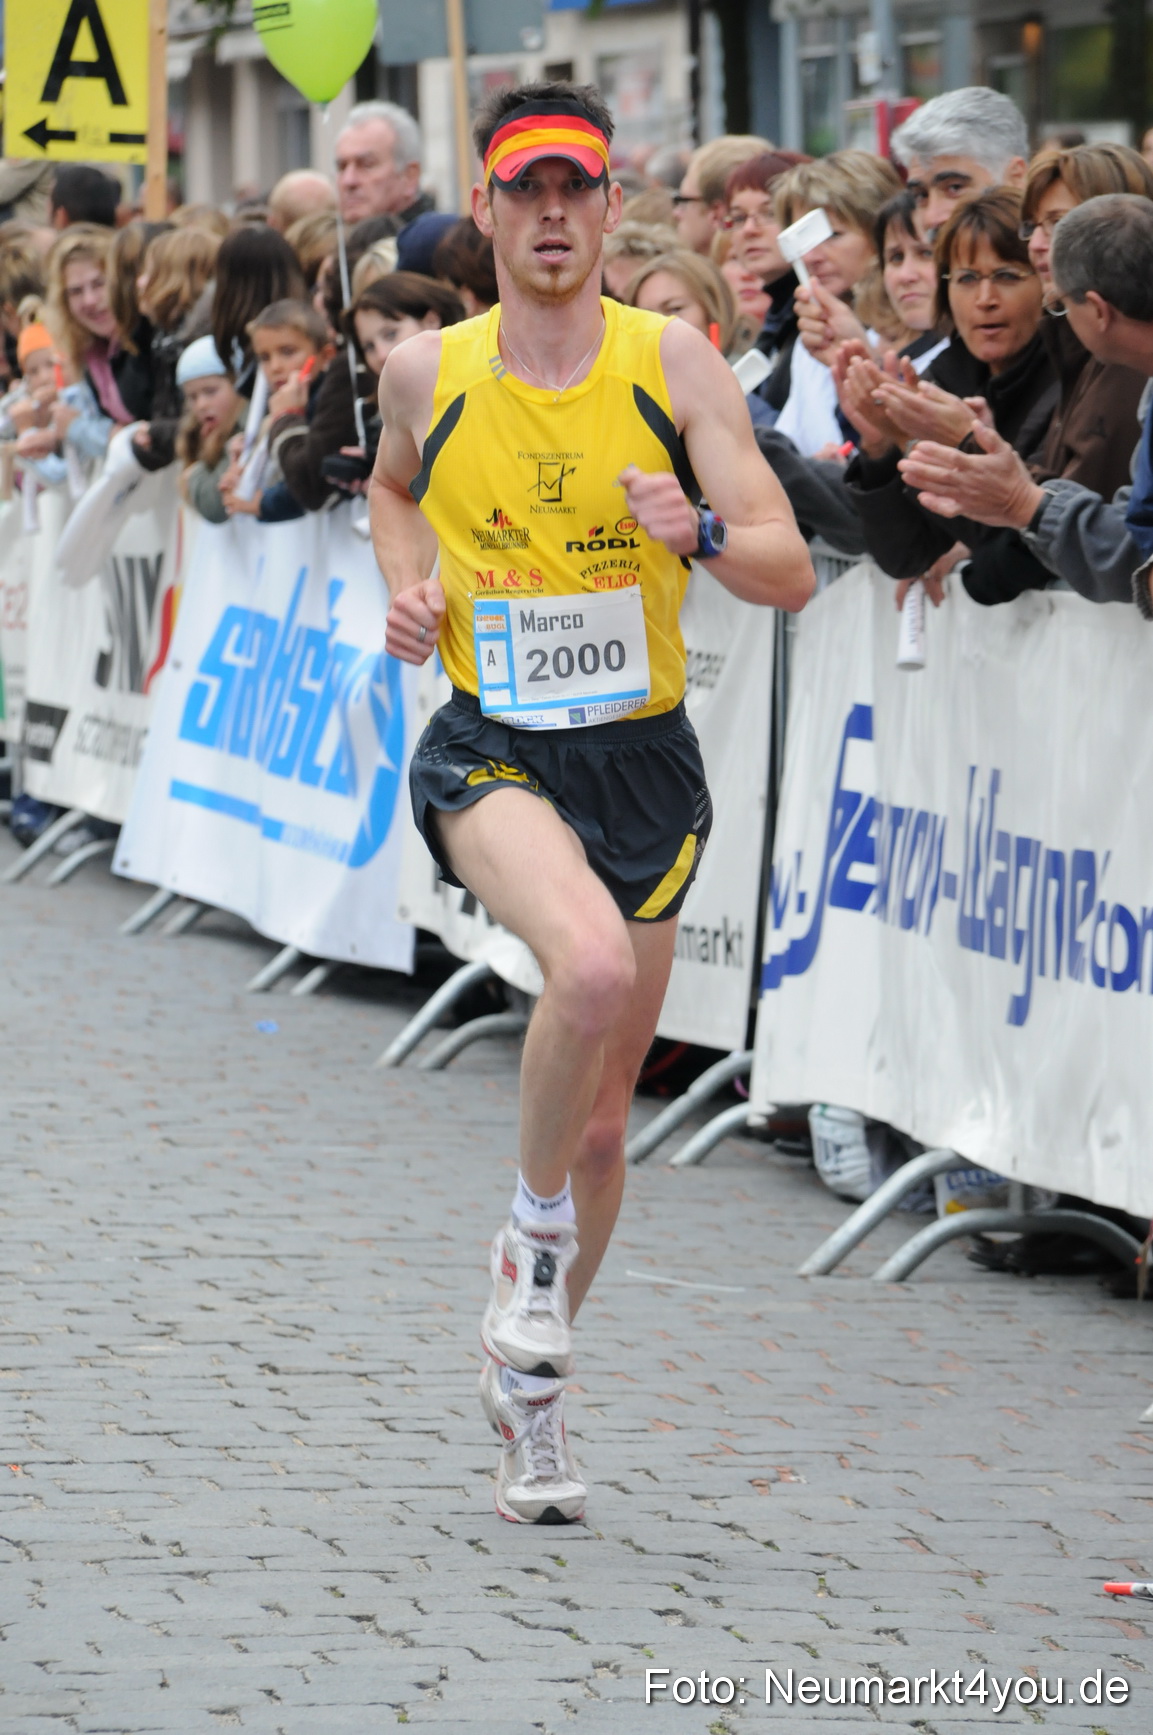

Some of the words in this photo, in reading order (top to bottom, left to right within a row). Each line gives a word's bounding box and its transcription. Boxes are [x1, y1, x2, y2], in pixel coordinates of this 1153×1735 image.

[40, 0, 128, 106] A
[517, 450, 584, 460] FONDSZENTRUM
[530, 504, 577, 514] NEUMARKT
[471, 527, 532, 543] NEUMARKTER
[475, 569, 495, 589] M
[502, 568, 522, 588] &
[529, 567, 544, 587] S
[580, 559, 640, 580] PIZZERIA
[593, 572, 637, 590] ELIO
[519, 609, 584, 633] Marco
[487, 649, 496, 666] A
[525, 639, 626, 682] 2000
[587, 697, 647, 716] PFLEIDERER
